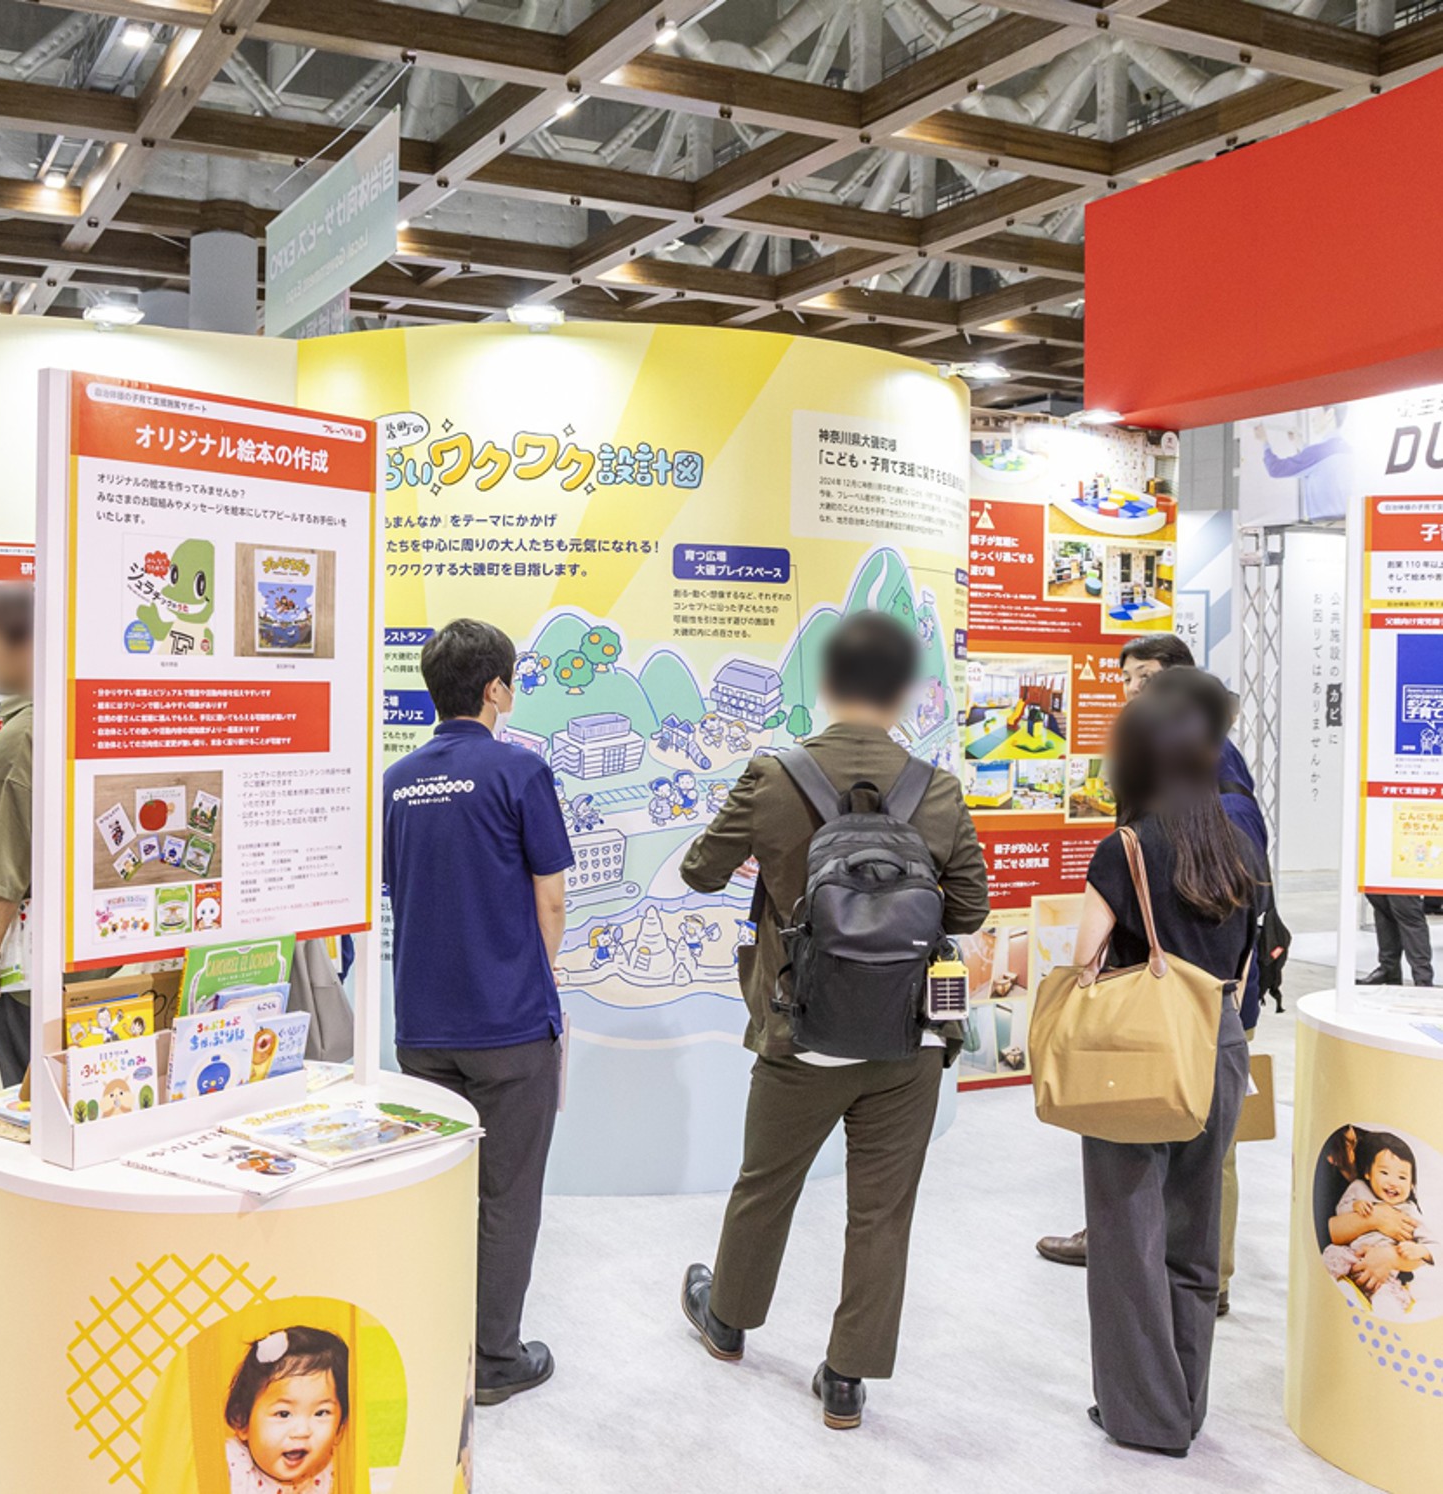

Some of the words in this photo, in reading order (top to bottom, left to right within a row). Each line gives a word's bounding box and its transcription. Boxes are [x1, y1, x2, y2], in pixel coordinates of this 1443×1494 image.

[134, 423, 329, 474] オリジナル絵本の作成
[96, 473, 246, 499] オリジナルの絵本を作ってみませんか？
[96, 510, 147, 526] いたします。
[684, 549, 727, 562] 育つ広場
[695, 563, 783, 579] 大磯プレイスペース
